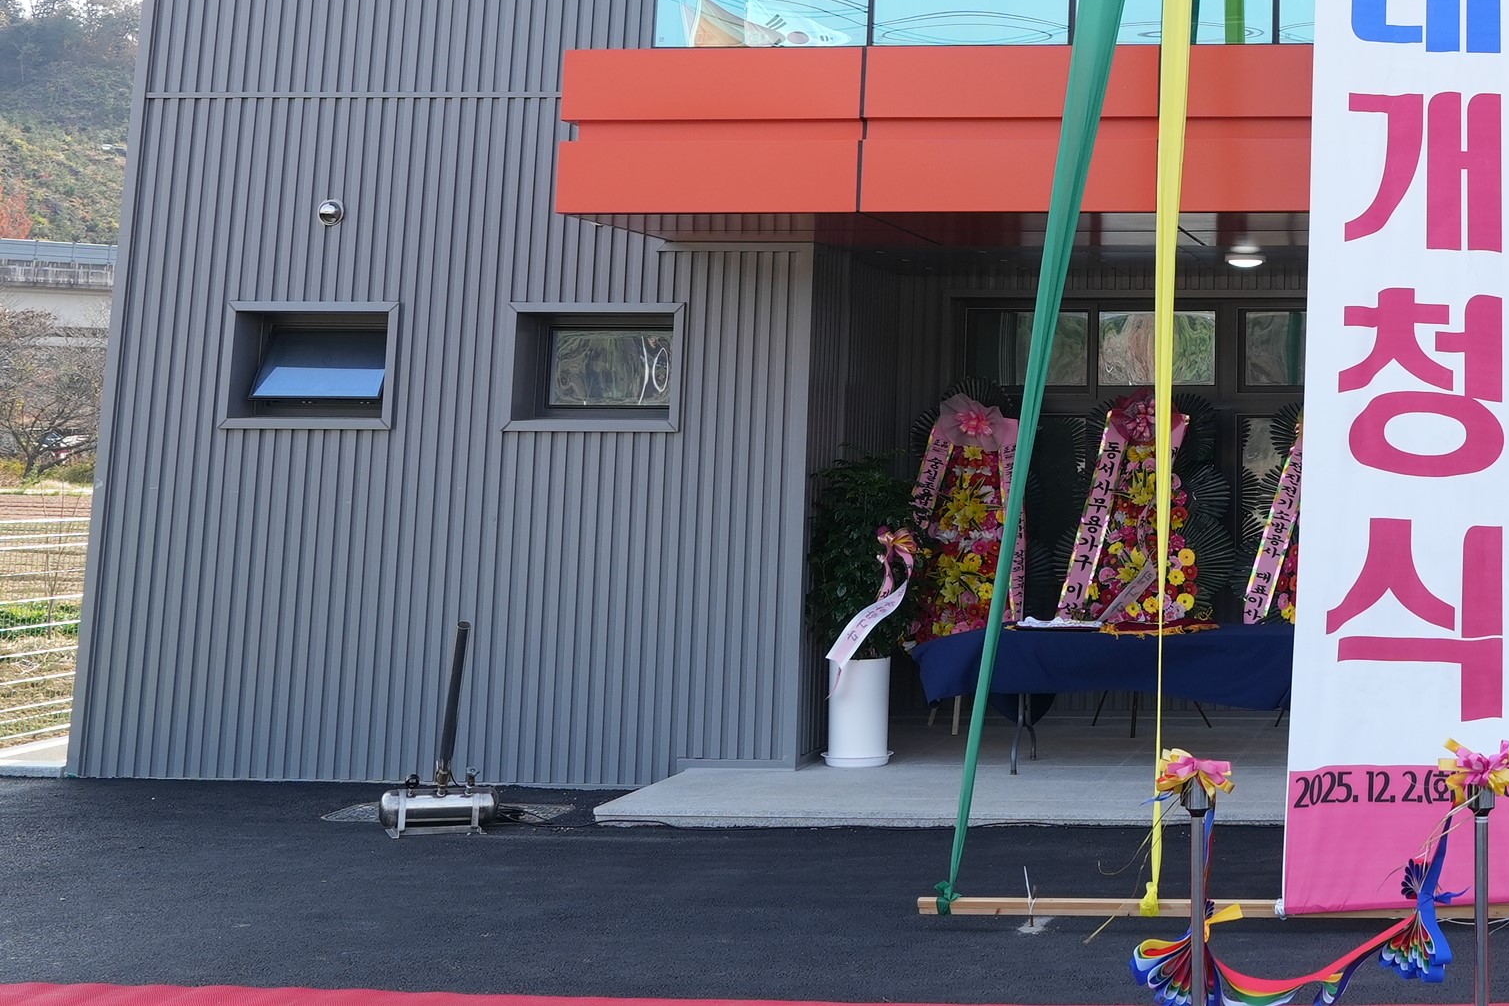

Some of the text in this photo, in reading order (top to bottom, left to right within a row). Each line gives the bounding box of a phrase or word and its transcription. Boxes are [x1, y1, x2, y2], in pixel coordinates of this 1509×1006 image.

[1073, 442, 1121, 573] 동서사무용가구
[1293, 771, 1359, 809] 2025.
[1366, 771, 1396, 803] 12.
